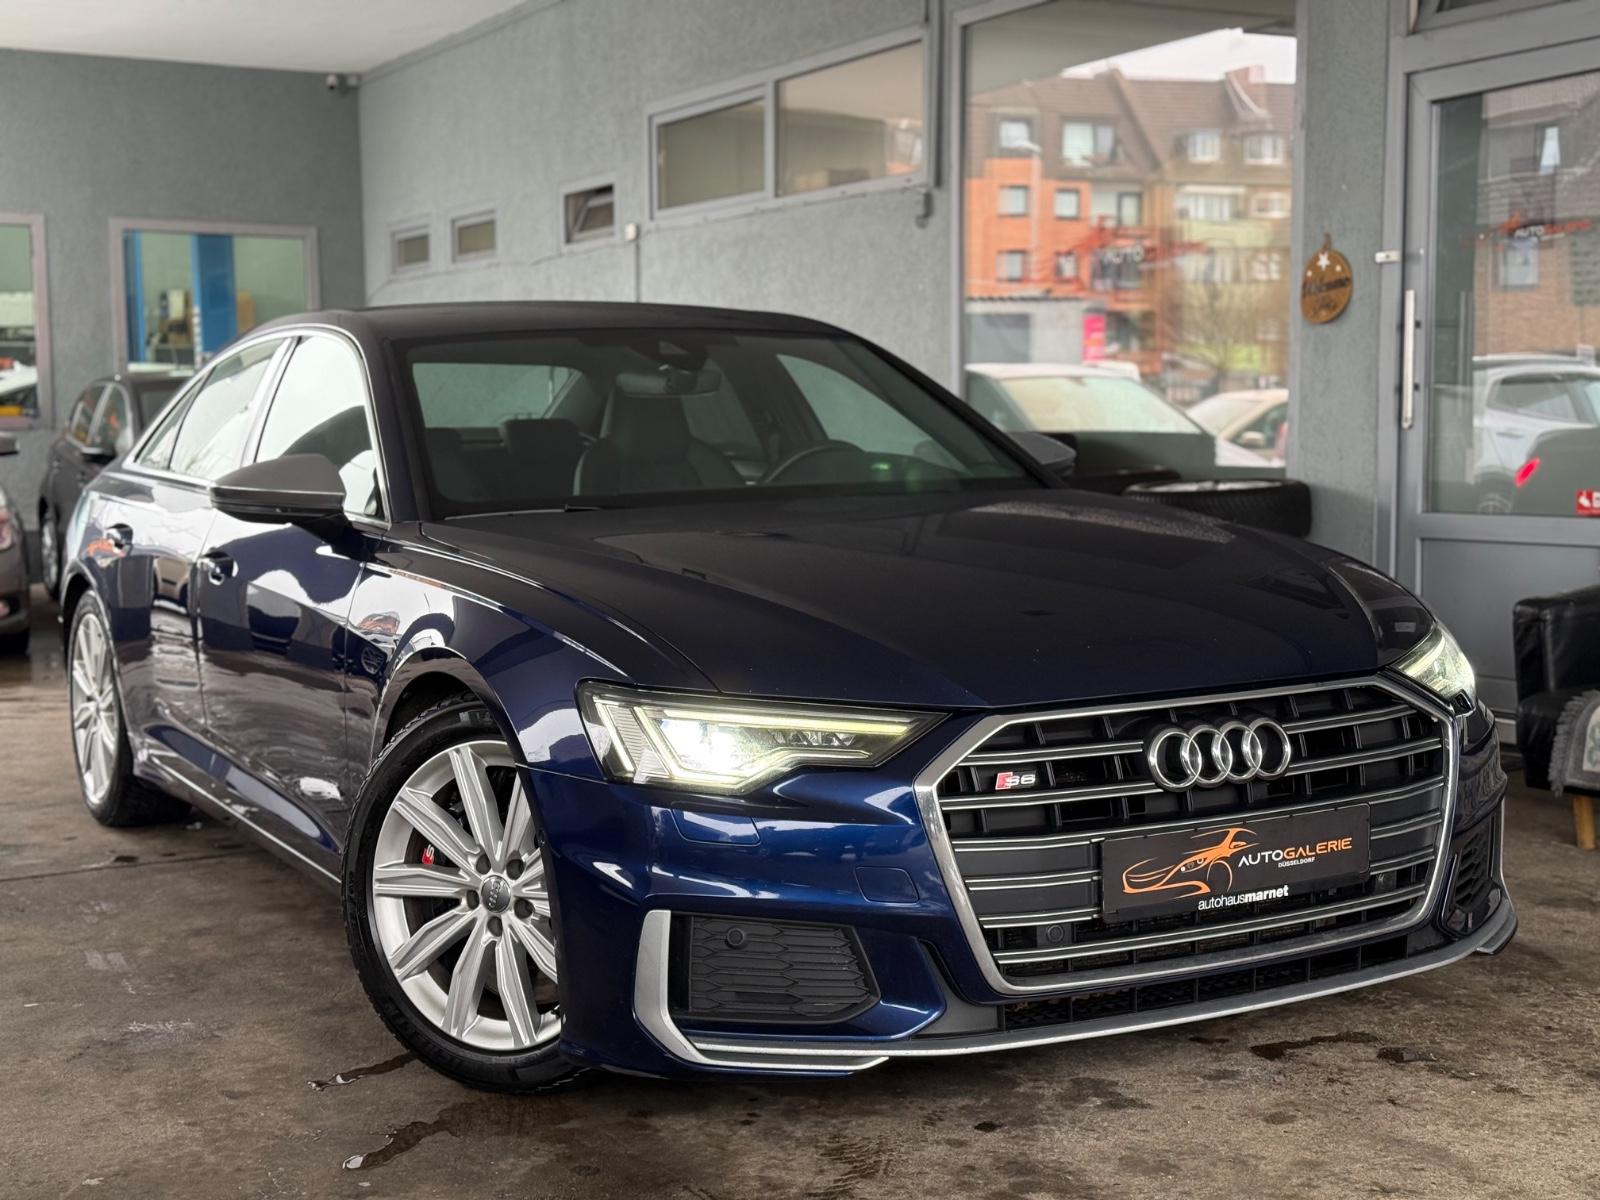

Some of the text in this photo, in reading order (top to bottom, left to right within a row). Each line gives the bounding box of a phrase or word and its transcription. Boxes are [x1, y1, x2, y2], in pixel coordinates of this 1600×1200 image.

[1003, 773, 1036, 788] S6
[1237, 837, 1353, 868] AUTOGALERIE
[1277, 855, 1316, 869] DÜSSELDORF
[1197, 884, 1289, 911] autohausmarnet
